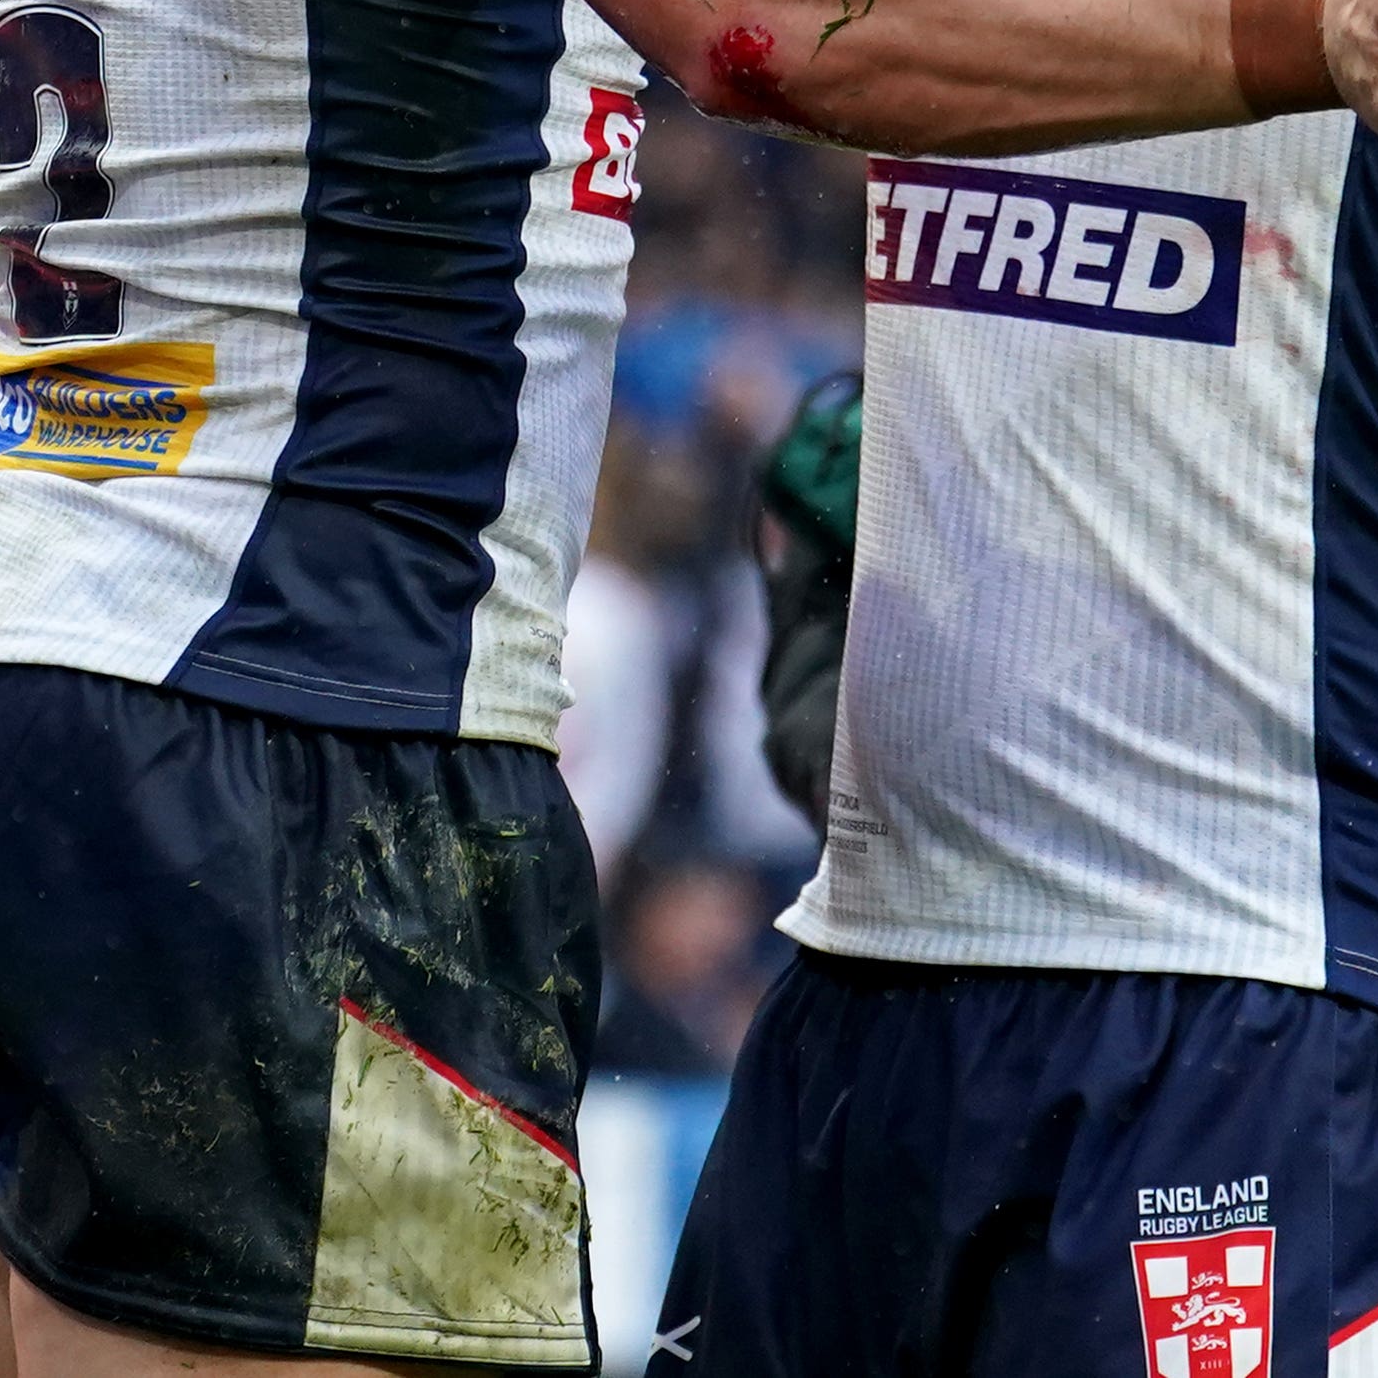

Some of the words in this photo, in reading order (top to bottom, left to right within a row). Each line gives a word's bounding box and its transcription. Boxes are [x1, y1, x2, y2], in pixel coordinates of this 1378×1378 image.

[33, 377, 187, 424] BUILDERS
[37, 420, 178, 455] WAREHOUSE
[1137, 1175, 1269, 1215] ENGLAND
[1139, 1216, 1200, 1237] RUGBY
[1202, 1205, 1269, 1232] LEAGUE
